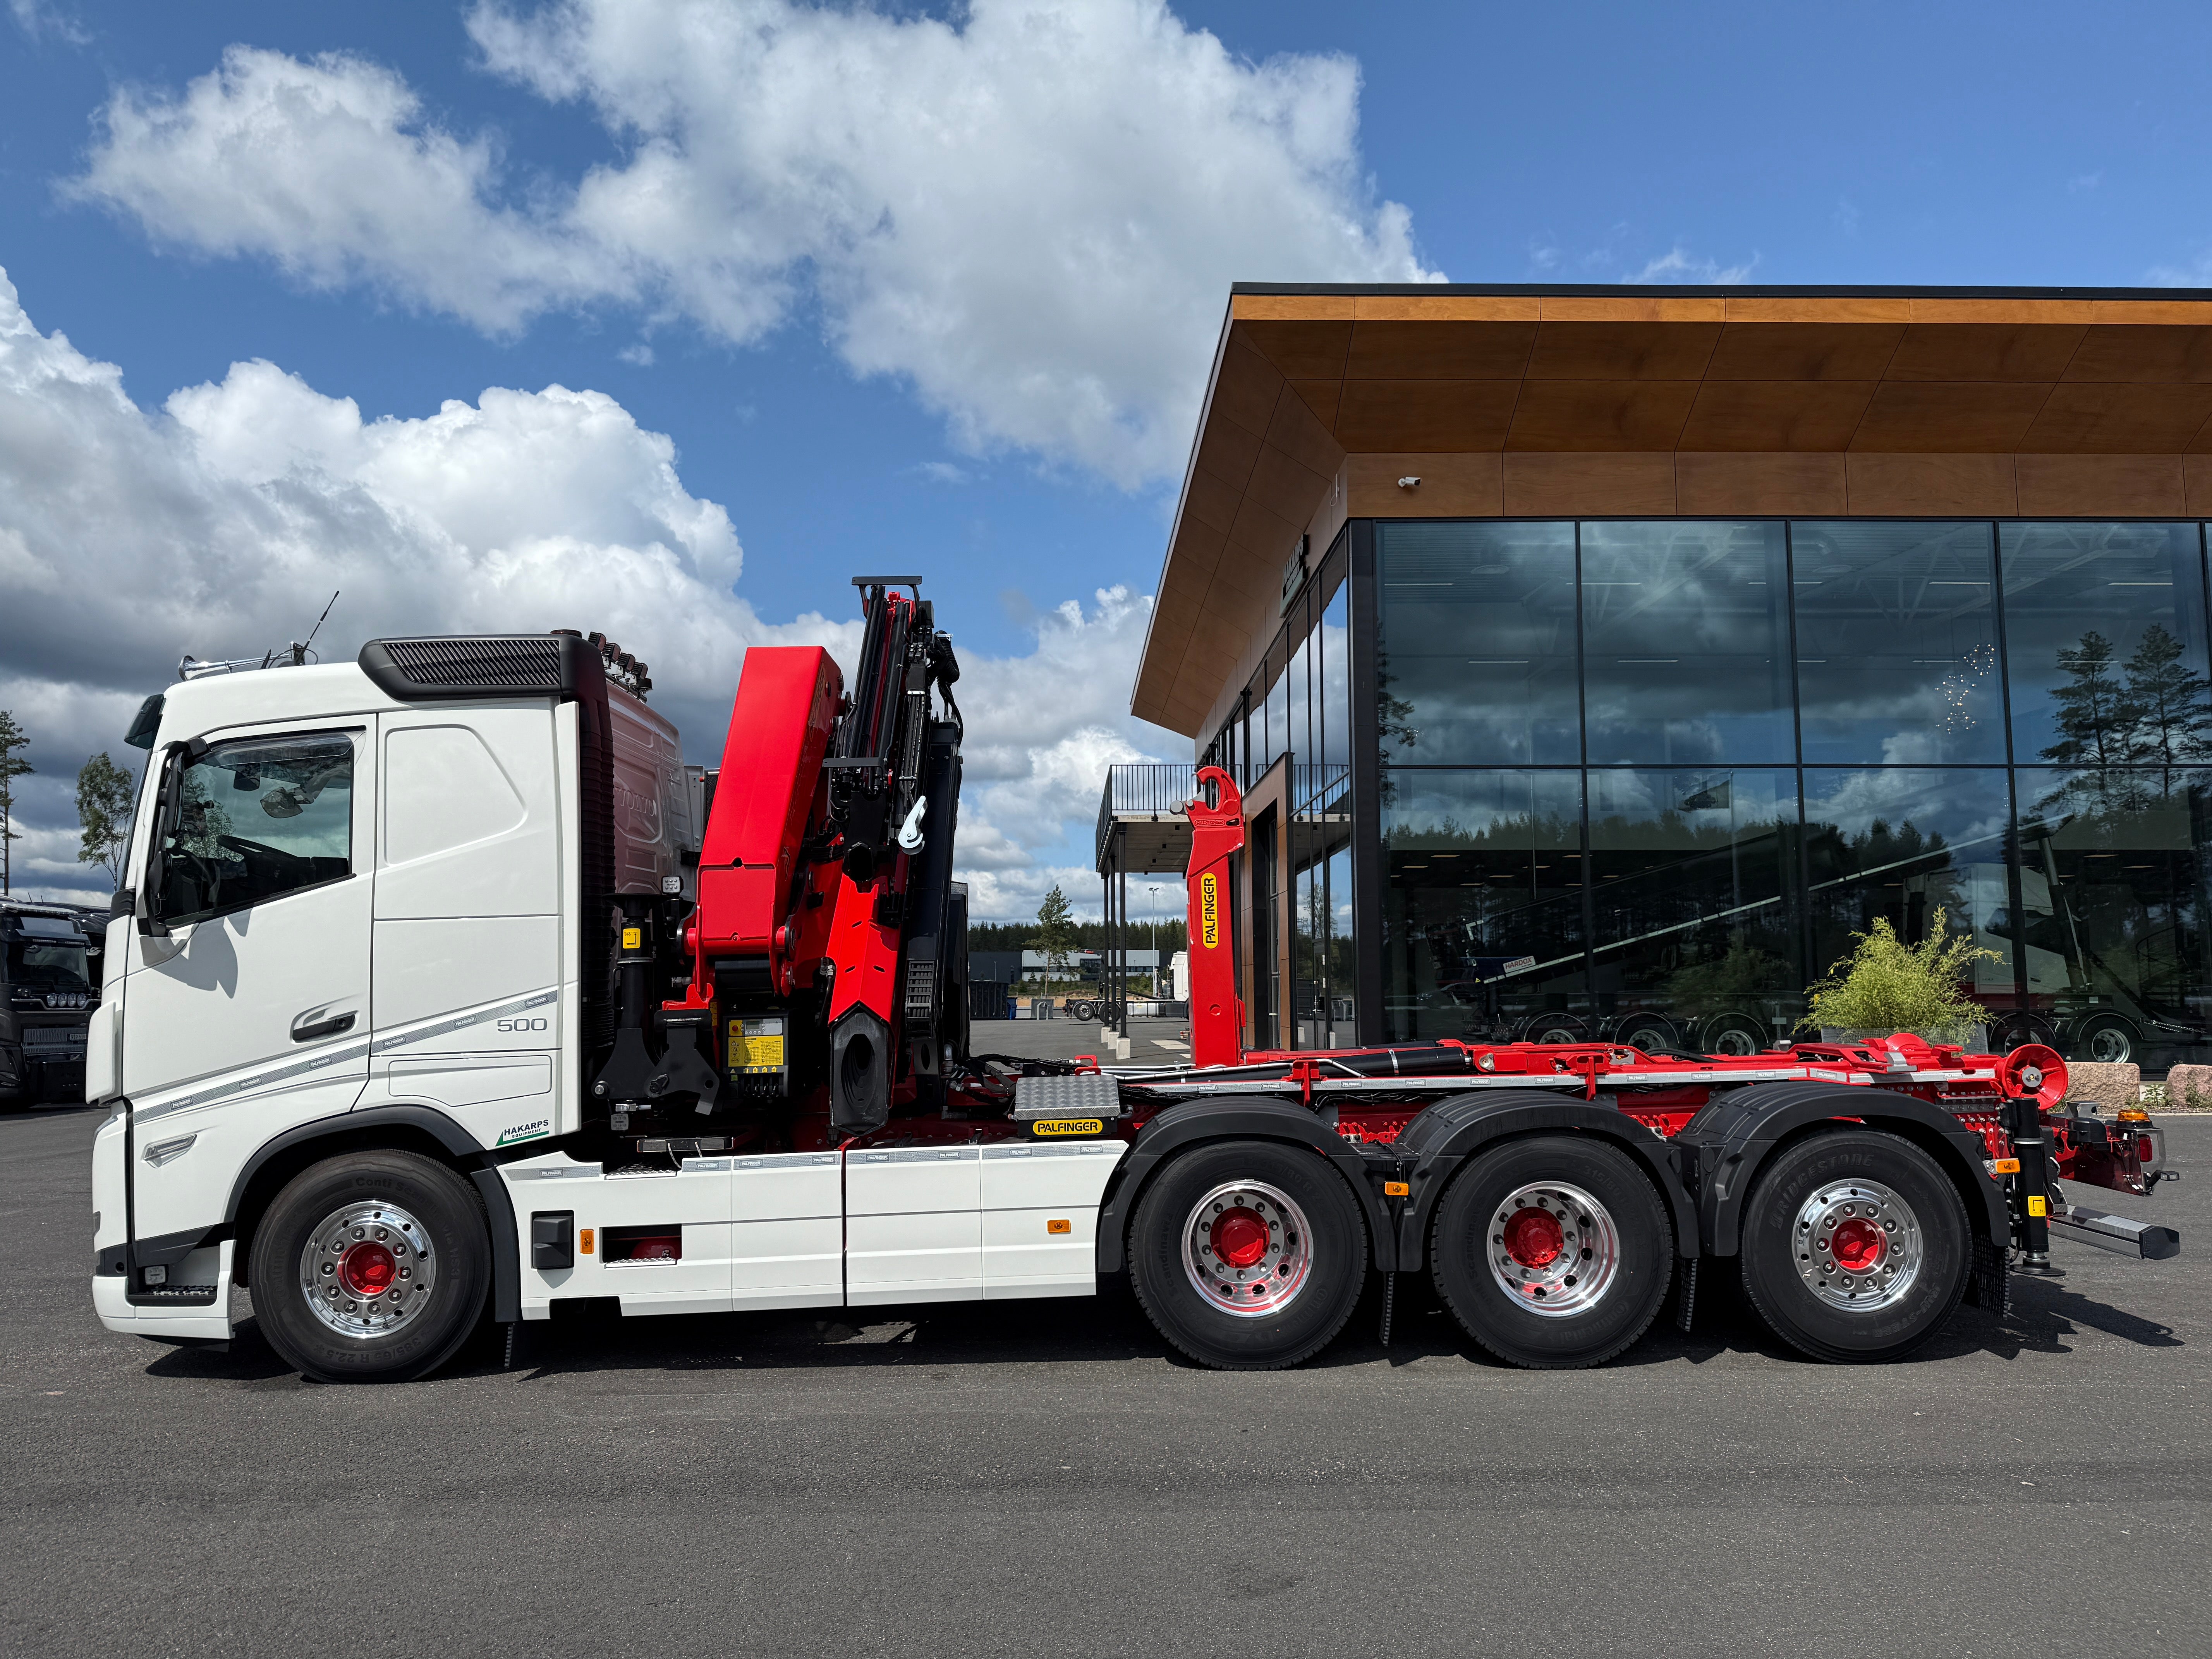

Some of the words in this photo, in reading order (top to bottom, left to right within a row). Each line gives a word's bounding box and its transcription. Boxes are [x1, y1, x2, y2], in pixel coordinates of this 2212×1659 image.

[1204, 878, 1216, 943] PALFINGER
[1505, 957, 1532, 969] HARDOX
[498, 1018, 547, 1032] 500
[504, 1120, 549, 1136] HAKARPS
[512, 1128, 541, 1138] EQUIPMENT
[1038, 1122, 1097, 1132] PALFINGER
[1581, 1163, 1624, 1197] 315/80
[1767, 1152, 1875, 1228] BRIDGESTONE
[355, 1176, 392, 1188] Conti
[448, 1246, 460, 1276] HS3
[324, 1348, 356, 1364] 22.5
[374, 1336, 422, 1362] 385/65
[360, 1354, 369, 1364] R
